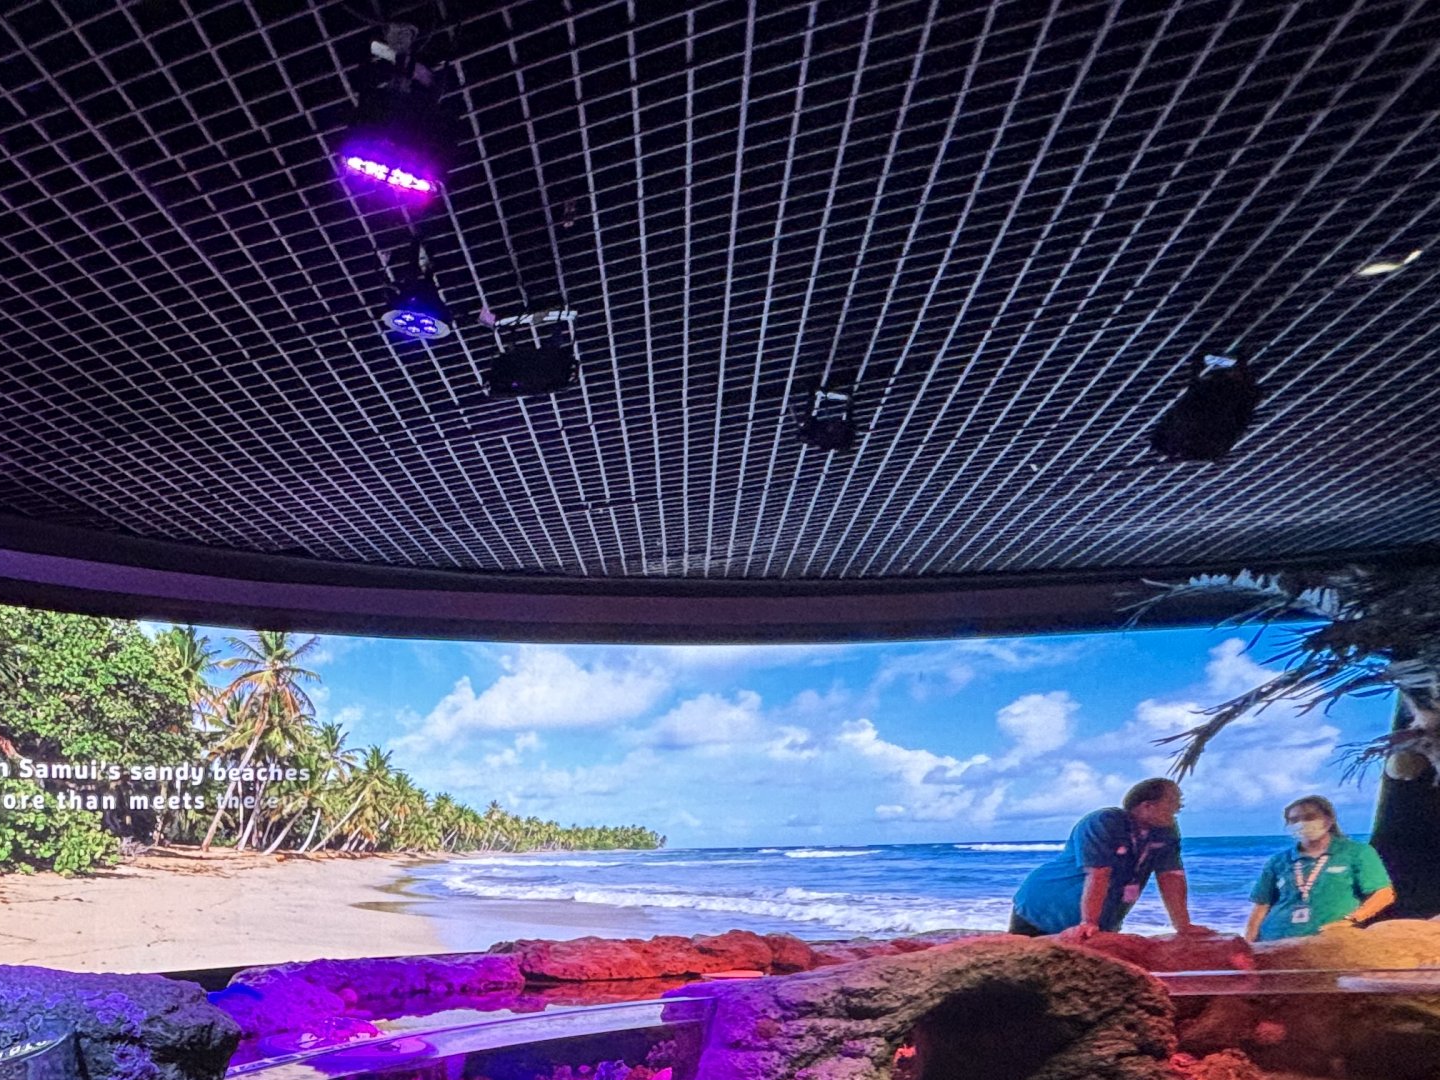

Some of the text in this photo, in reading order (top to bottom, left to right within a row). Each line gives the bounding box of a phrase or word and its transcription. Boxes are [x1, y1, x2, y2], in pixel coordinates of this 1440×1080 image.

[19, 758, 122, 780] Samui's
[130, 761, 205, 786] sandy
[213, 762, 311, 782] beaches
[57, 789, 117, 810] than
[129, 791, 206, 811] meets
[216, 791, 257, 809] the
